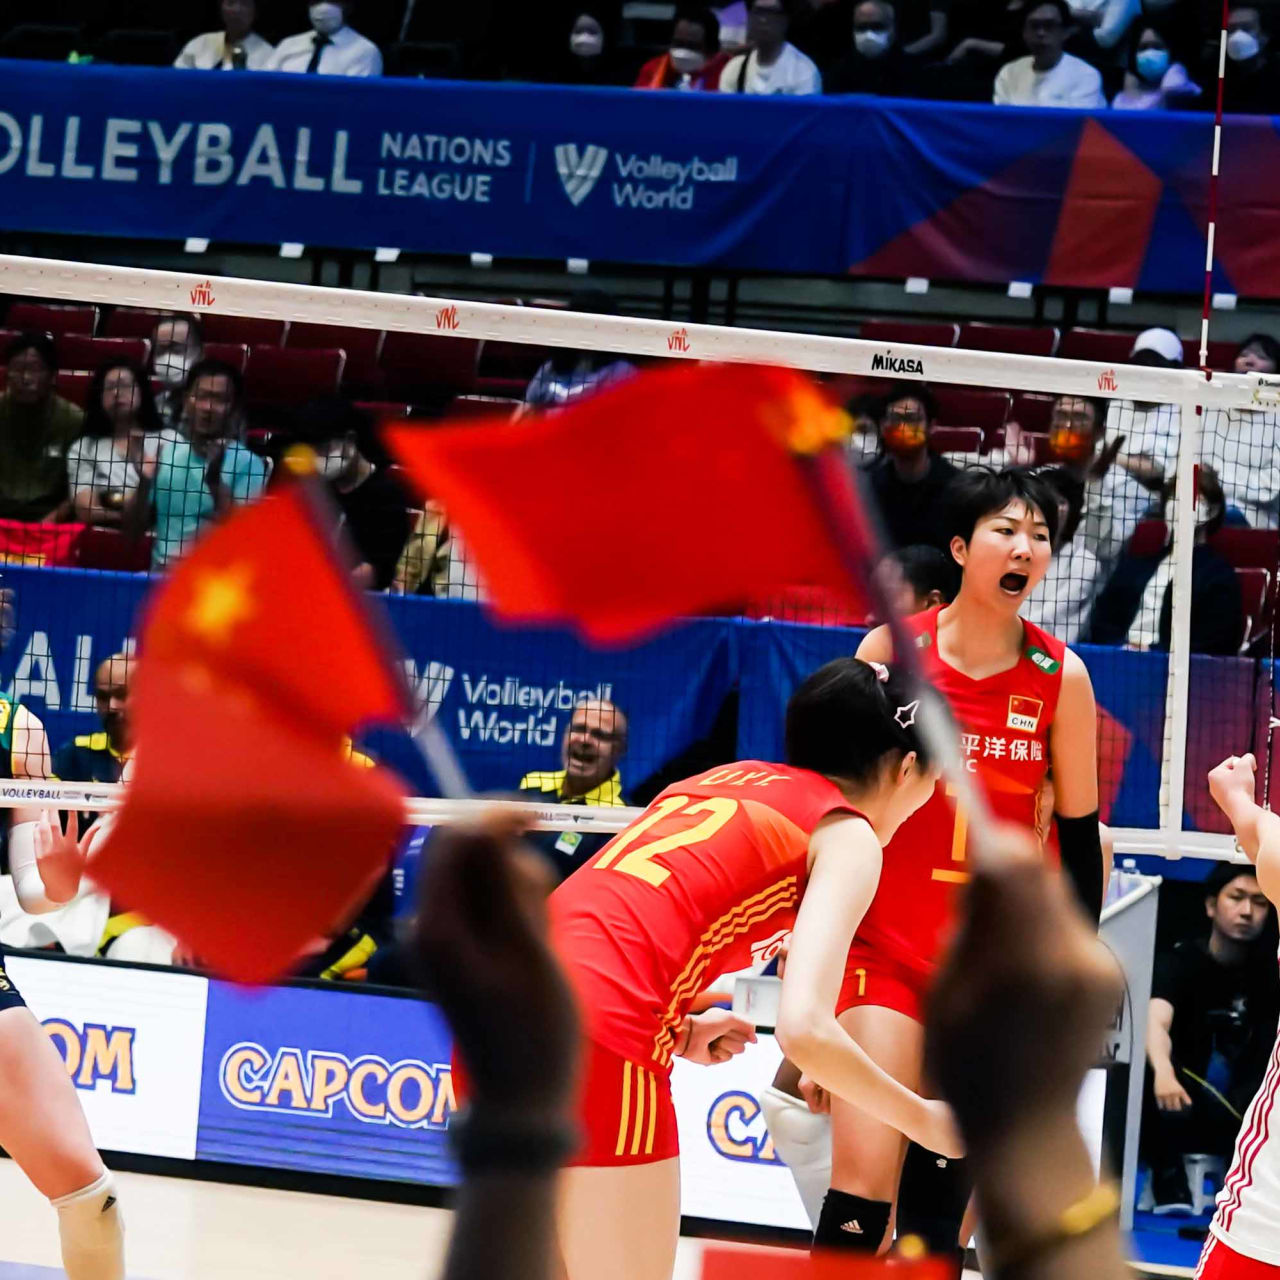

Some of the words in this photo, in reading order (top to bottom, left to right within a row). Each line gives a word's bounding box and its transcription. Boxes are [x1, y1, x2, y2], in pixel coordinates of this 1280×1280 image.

[380, 131, 511, 166] NATIONS
[615, 152, 737, 183] Volleyball
[377, 168, 491, 202] LEAGUE
[613, 182, 694, 210] World
[871, 349, 924, 375] MIKASA
[458, 708, 557, 746] World
[1011, 717, 1034, 729] CHN
[2, 788, 61, 800] VOLLEYBALL
[592, 795, 738, 888] 12
[855, 968, 867, 996] 1
